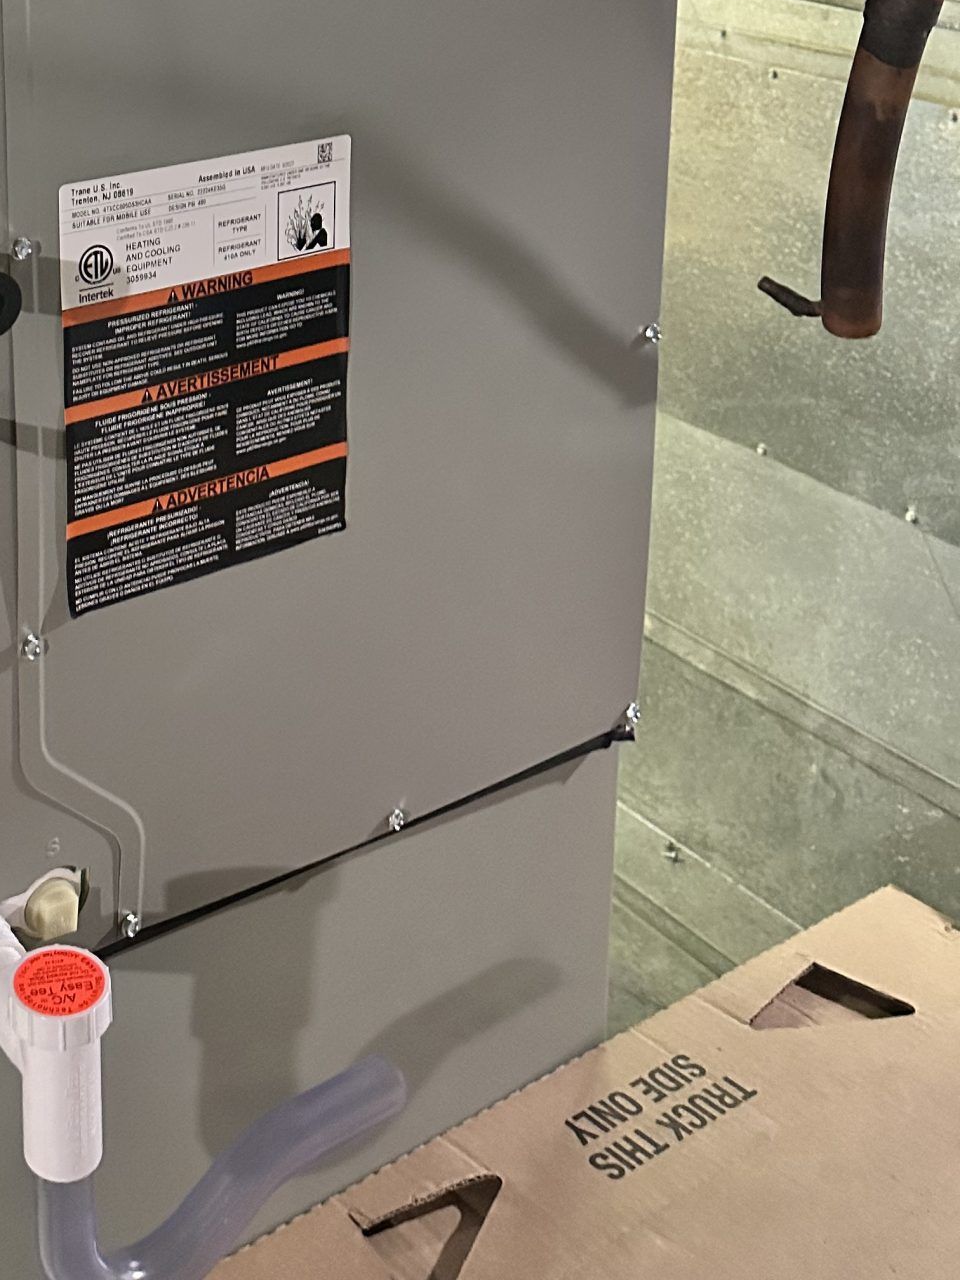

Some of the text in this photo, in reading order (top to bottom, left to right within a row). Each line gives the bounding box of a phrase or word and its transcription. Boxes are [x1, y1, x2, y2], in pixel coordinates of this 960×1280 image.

[198, 168, 233, 183] Assembled
[234, 167, 240, 176] in
[242, 164, 255, 175] USA
[71, 185, 90, 197] Trane
[108, 179, 122, 190] Inc.
[102, 191, 111, 200] NJ
[71, 207, 151, 229] SUITABLE FOR MOBILE USE
[217, 212, 261, 228] REFRIGERANT
[232, 224, 247, 234] TYPE
[125, 236, 161, 251] HEATING
[125, 243, 181, 262] AND COOLING
[217, 237, 261, 253] REFRIGERANT
[239, 247, 255, 257] ONLY
[126, 255, 172, 274] EQUIPMENT
[181, 270, 253, 300] WARNING
[78, 286, 114, 304] Intertek
[107, 312, 150, 328] PRESSURIZED
[114, 320, 146, 334] IMPROPER
[155, 354, 279, 400] AVERTISSEMENT
[94, 415, 116, 428] FLUIDE
[159, 400, 176, 411] SOUS
[100, 421, 122, 434] FLUIDE
[166, 465, 269, 509] ADVERTENCIA
[30, 981, 94, 997] Easy Tee
[51, 993, 76, 1005] A/C
[564, 1054, 707, 1146] SIDE ONLY
[589, 1076, 758, 1180] TRUCK THIS
